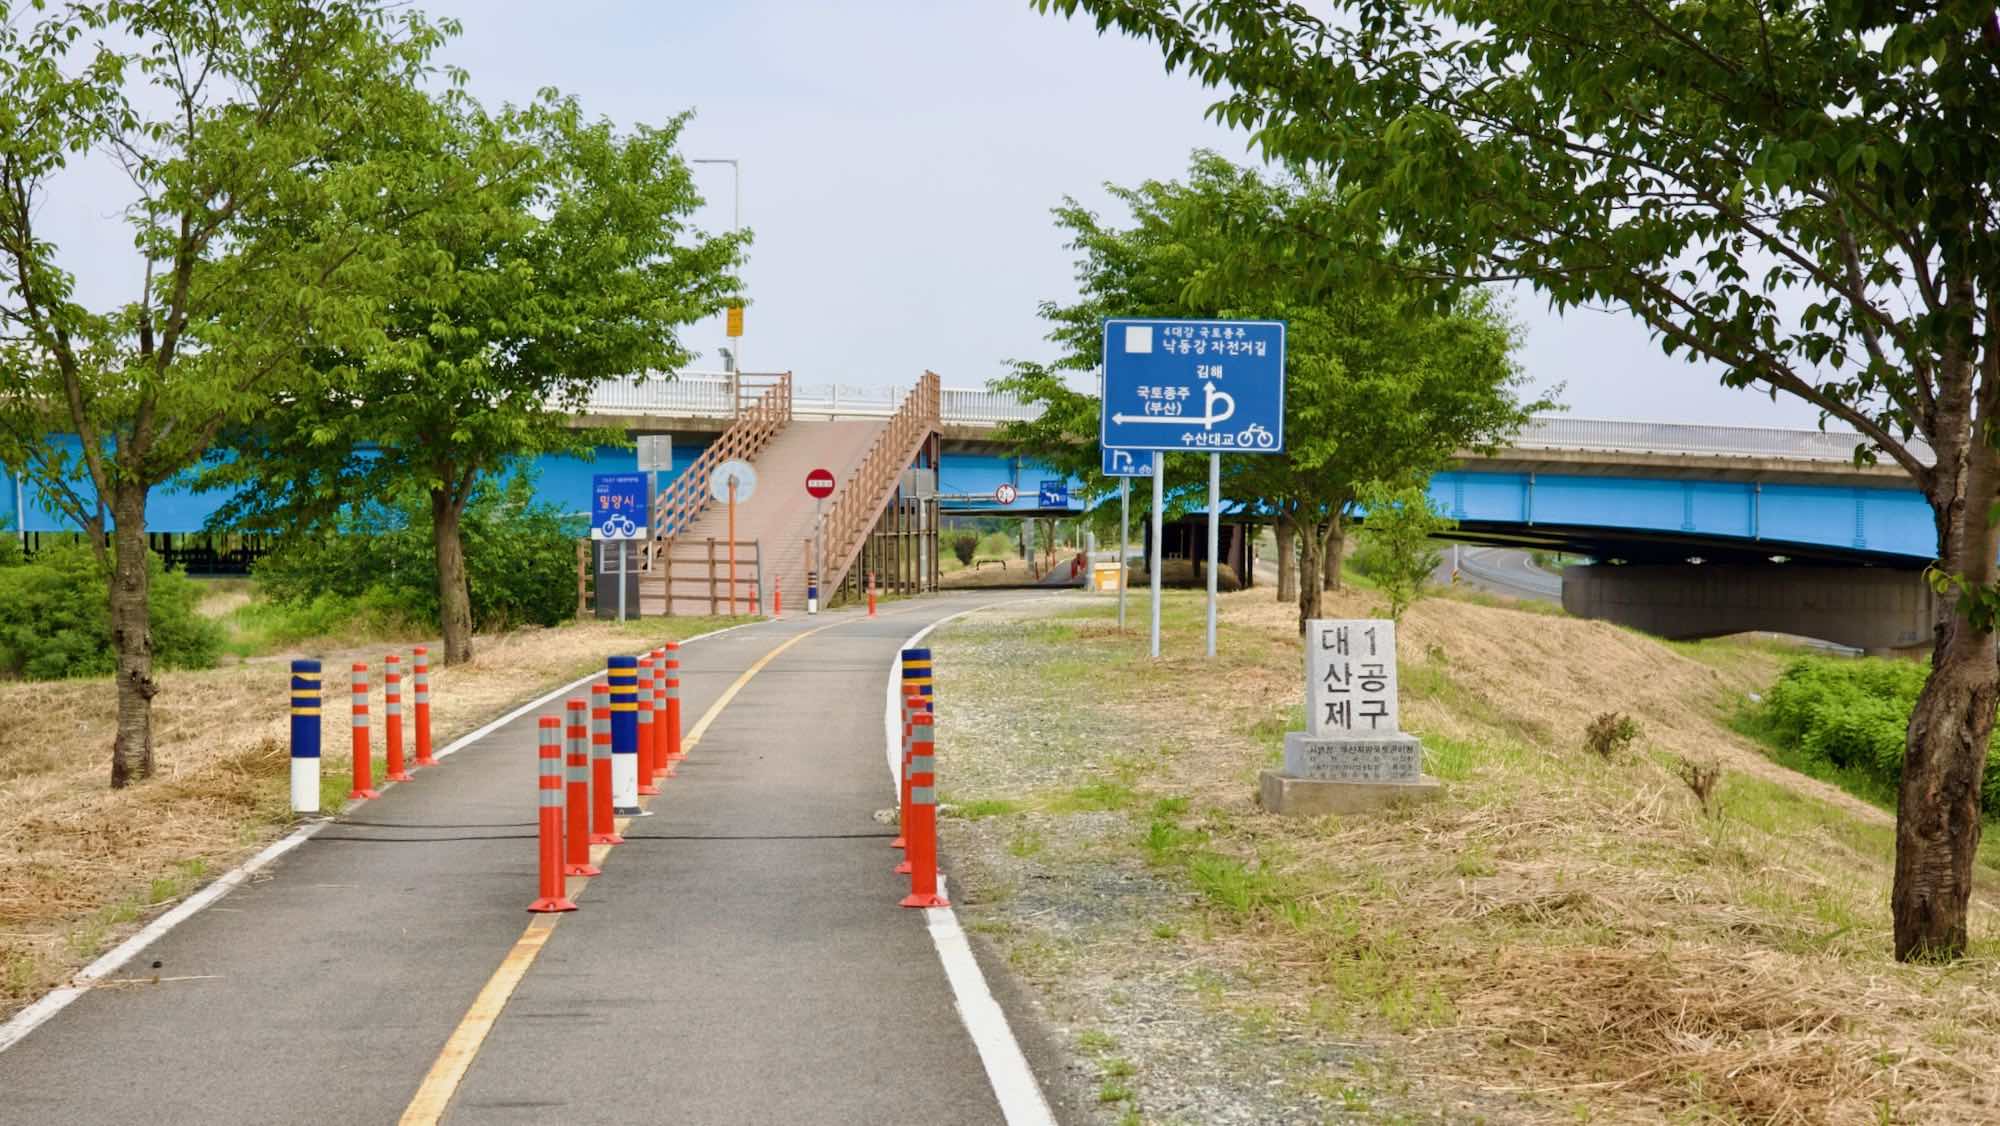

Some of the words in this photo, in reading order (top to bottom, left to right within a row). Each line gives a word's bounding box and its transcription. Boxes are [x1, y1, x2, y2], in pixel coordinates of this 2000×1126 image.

[1163, 326, 1194, 339] 4대강
[1200, 326, 1246, 340] 국토종주
[1162, 338, 1207, 355] 낙동강
[1211, 340, 1267, 357] 자전거길
[1196, 364, 1223, 379] 김해
[1136, 386, 1191, 401] 국토종주
[1144, 401, 1183, 416] (부산)
[1181, 432, 1235, 447] 수산대교
[599, 494, 635, 509] 밀양시
[1321, 626, 1353, 730] 대산제
[1357, 626, 1390, 730] 1공구
